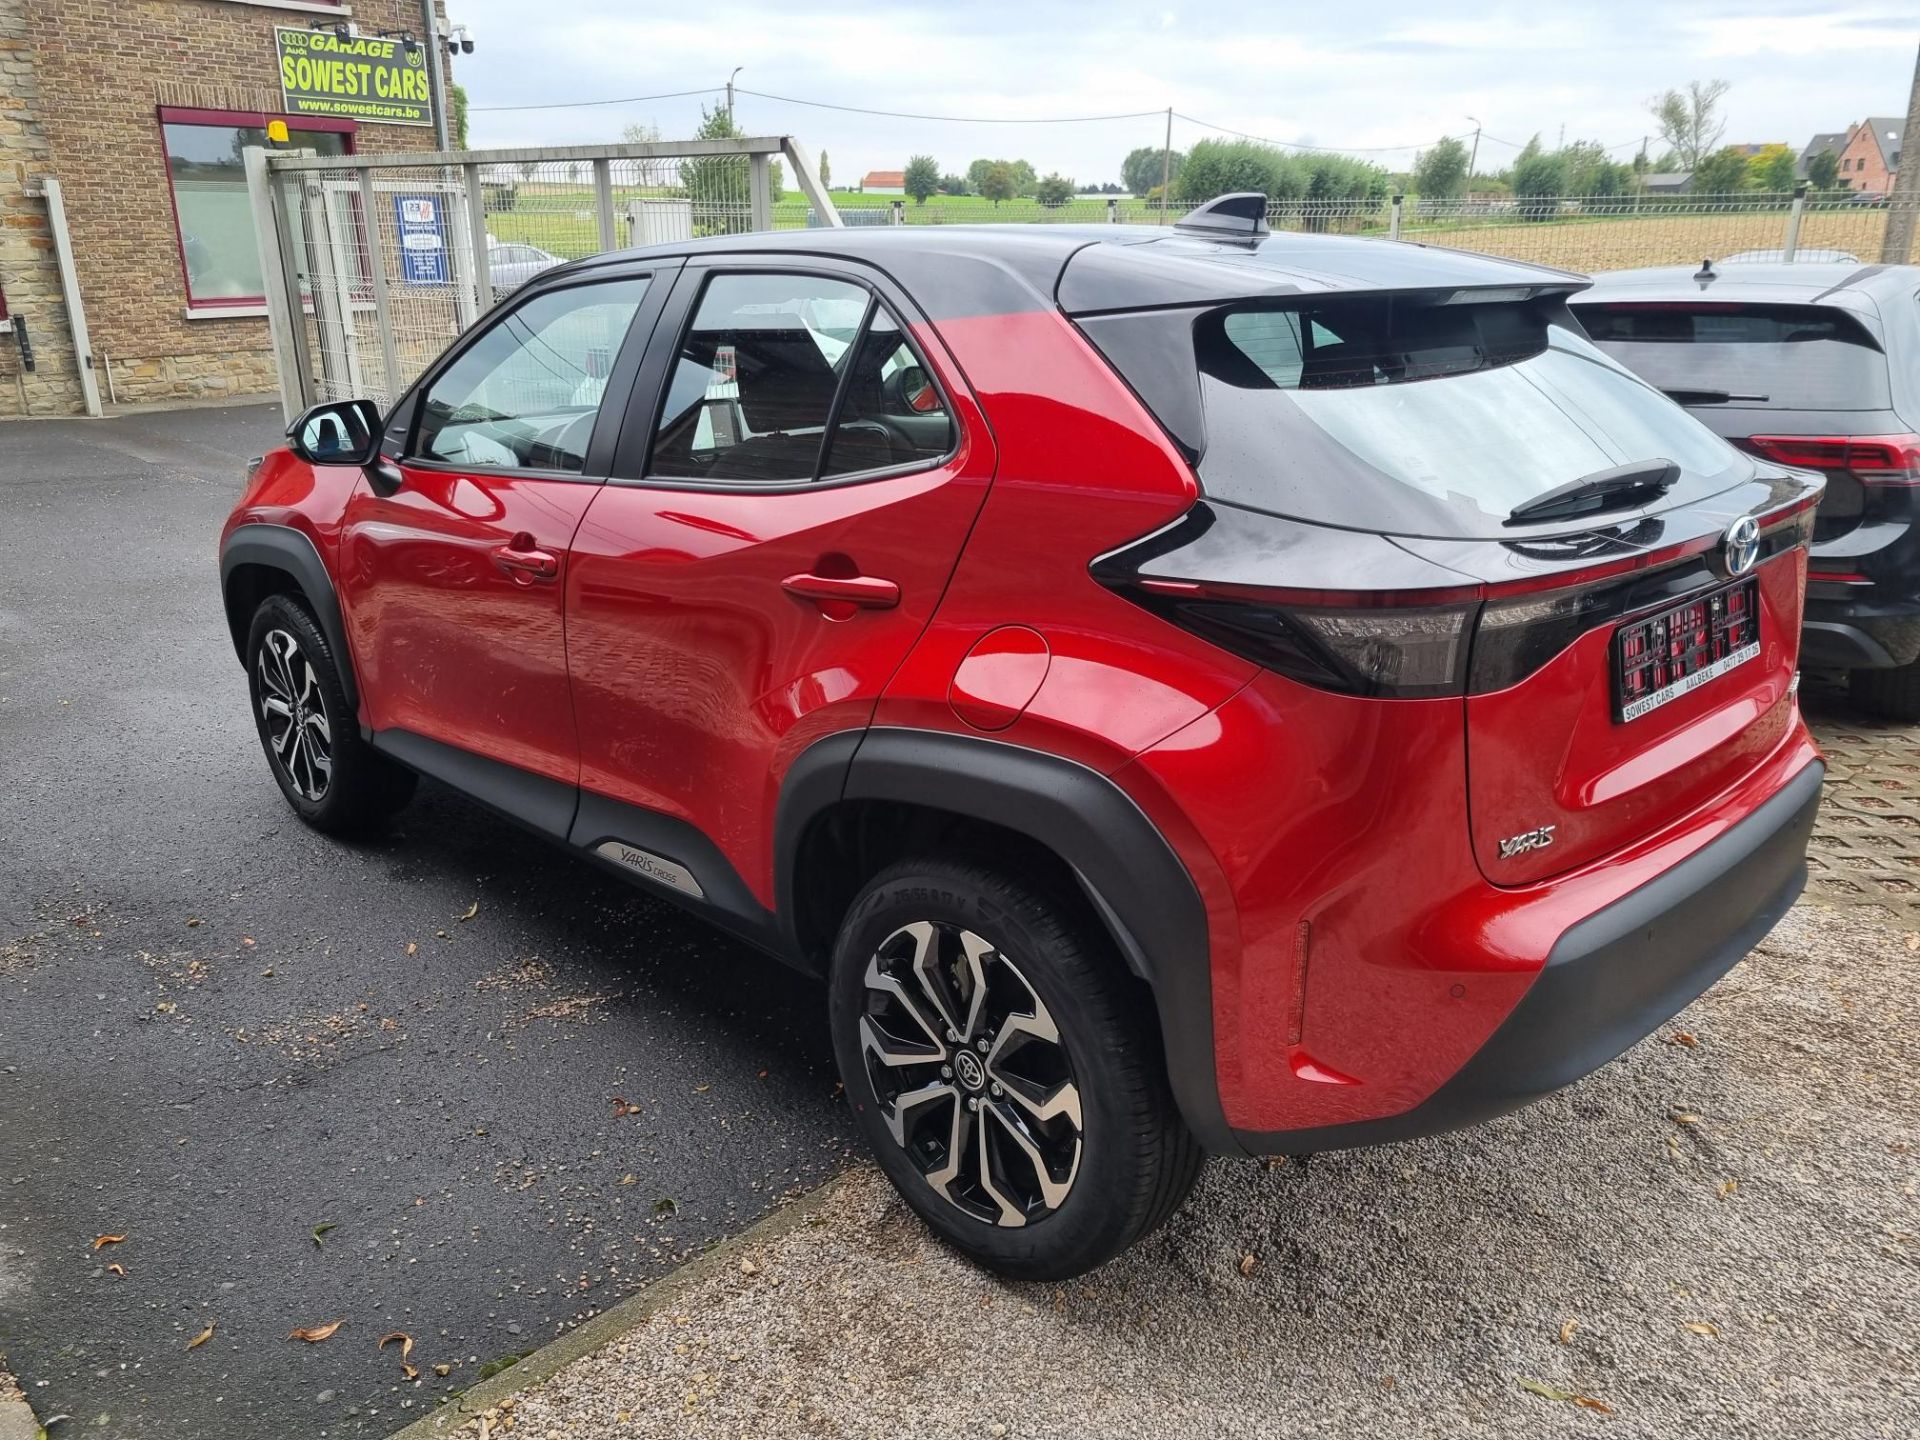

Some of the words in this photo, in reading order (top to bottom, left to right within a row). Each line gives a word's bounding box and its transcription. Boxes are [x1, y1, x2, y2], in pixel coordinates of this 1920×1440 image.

[309, 34, 395, 59] GARAGE
[282, 55, 371, 96] SOWEST
[375, 65, 428, 102] CARS
[298, 100, 420, 119] www.sowestcars.be
[1625, 694, 1655, 720] SOWEST
[1656, 687, 1675, 705] CARS
[1686, 668, 1714, 691] AALBEKE
[653, 867, 678, 883] CROSS
